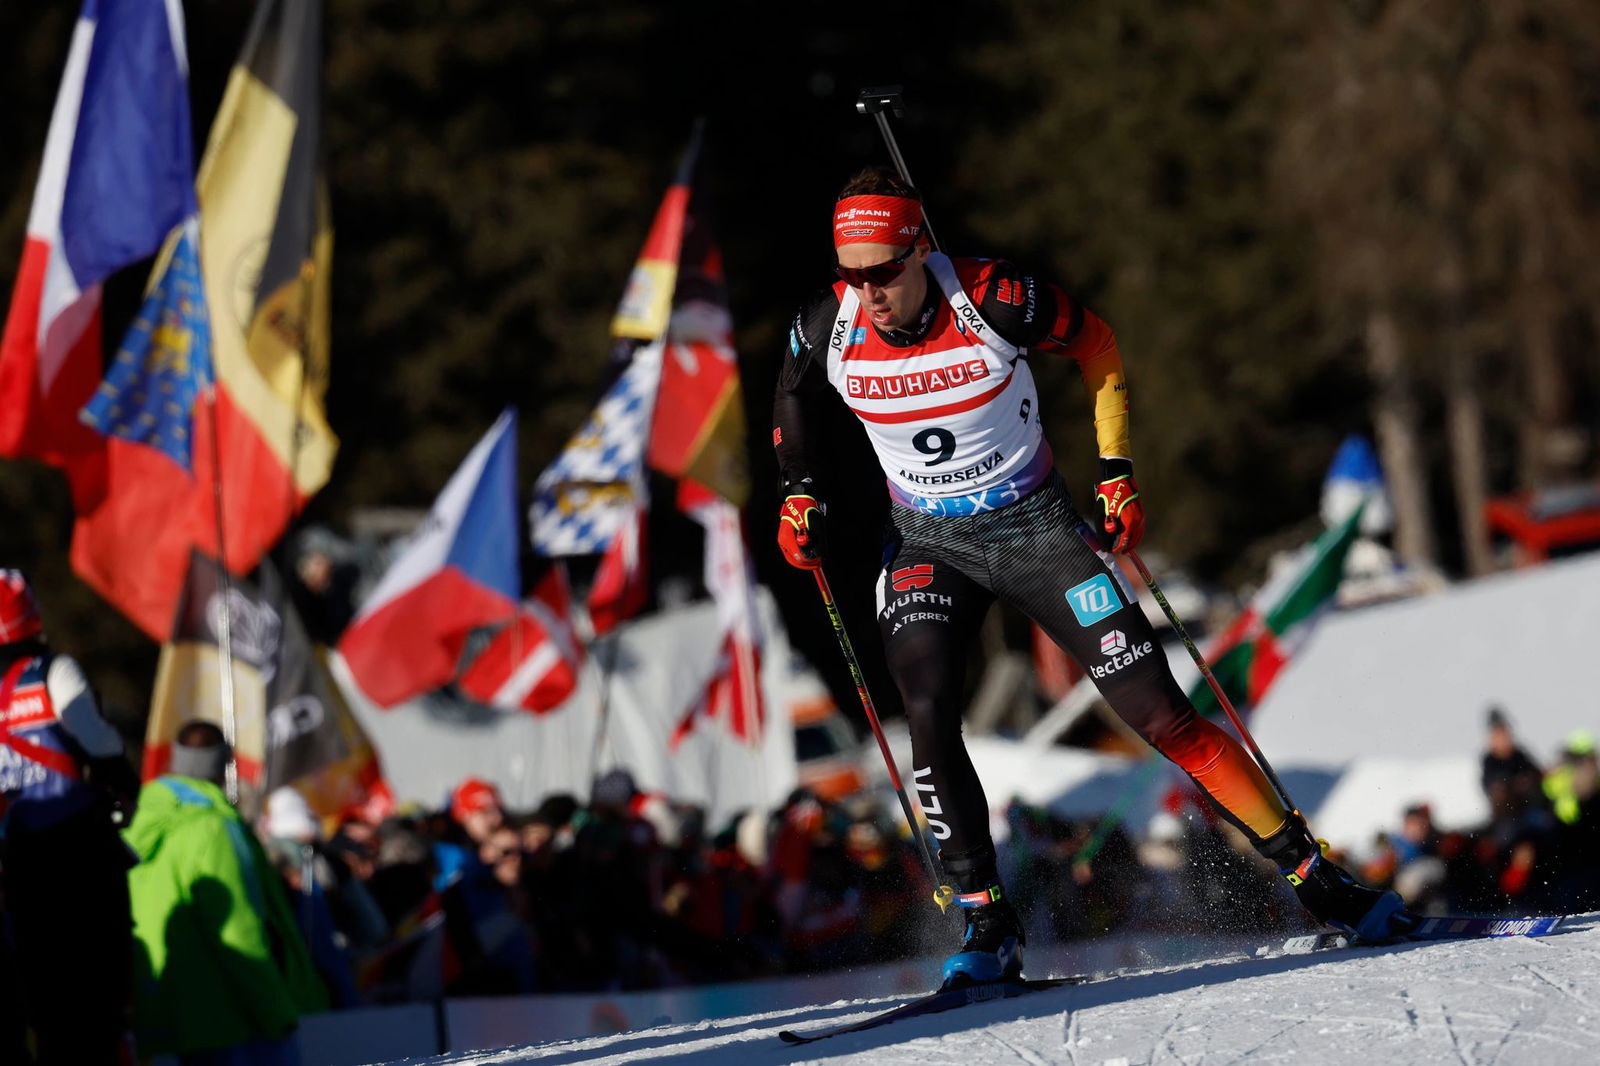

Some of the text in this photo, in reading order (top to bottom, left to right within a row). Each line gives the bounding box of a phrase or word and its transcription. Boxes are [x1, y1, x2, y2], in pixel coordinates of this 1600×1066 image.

[957, 303, 986, 334] JOKA
[831, 318, 848, 352] JOKA
[848, 361, 988, 397] BAUHAUS
[912, 428, 957, 467] 9
[1109, 483, 1125, 513] LEKI
[883, 592, 952, 620] WÜRTH
[1073, 583, 1115, 613] TQ
[901, 612, 950, 625] TERREX
[1090, 641, 1153, 679] tectake
[1482, 920, 1535, 935] SALOMON
